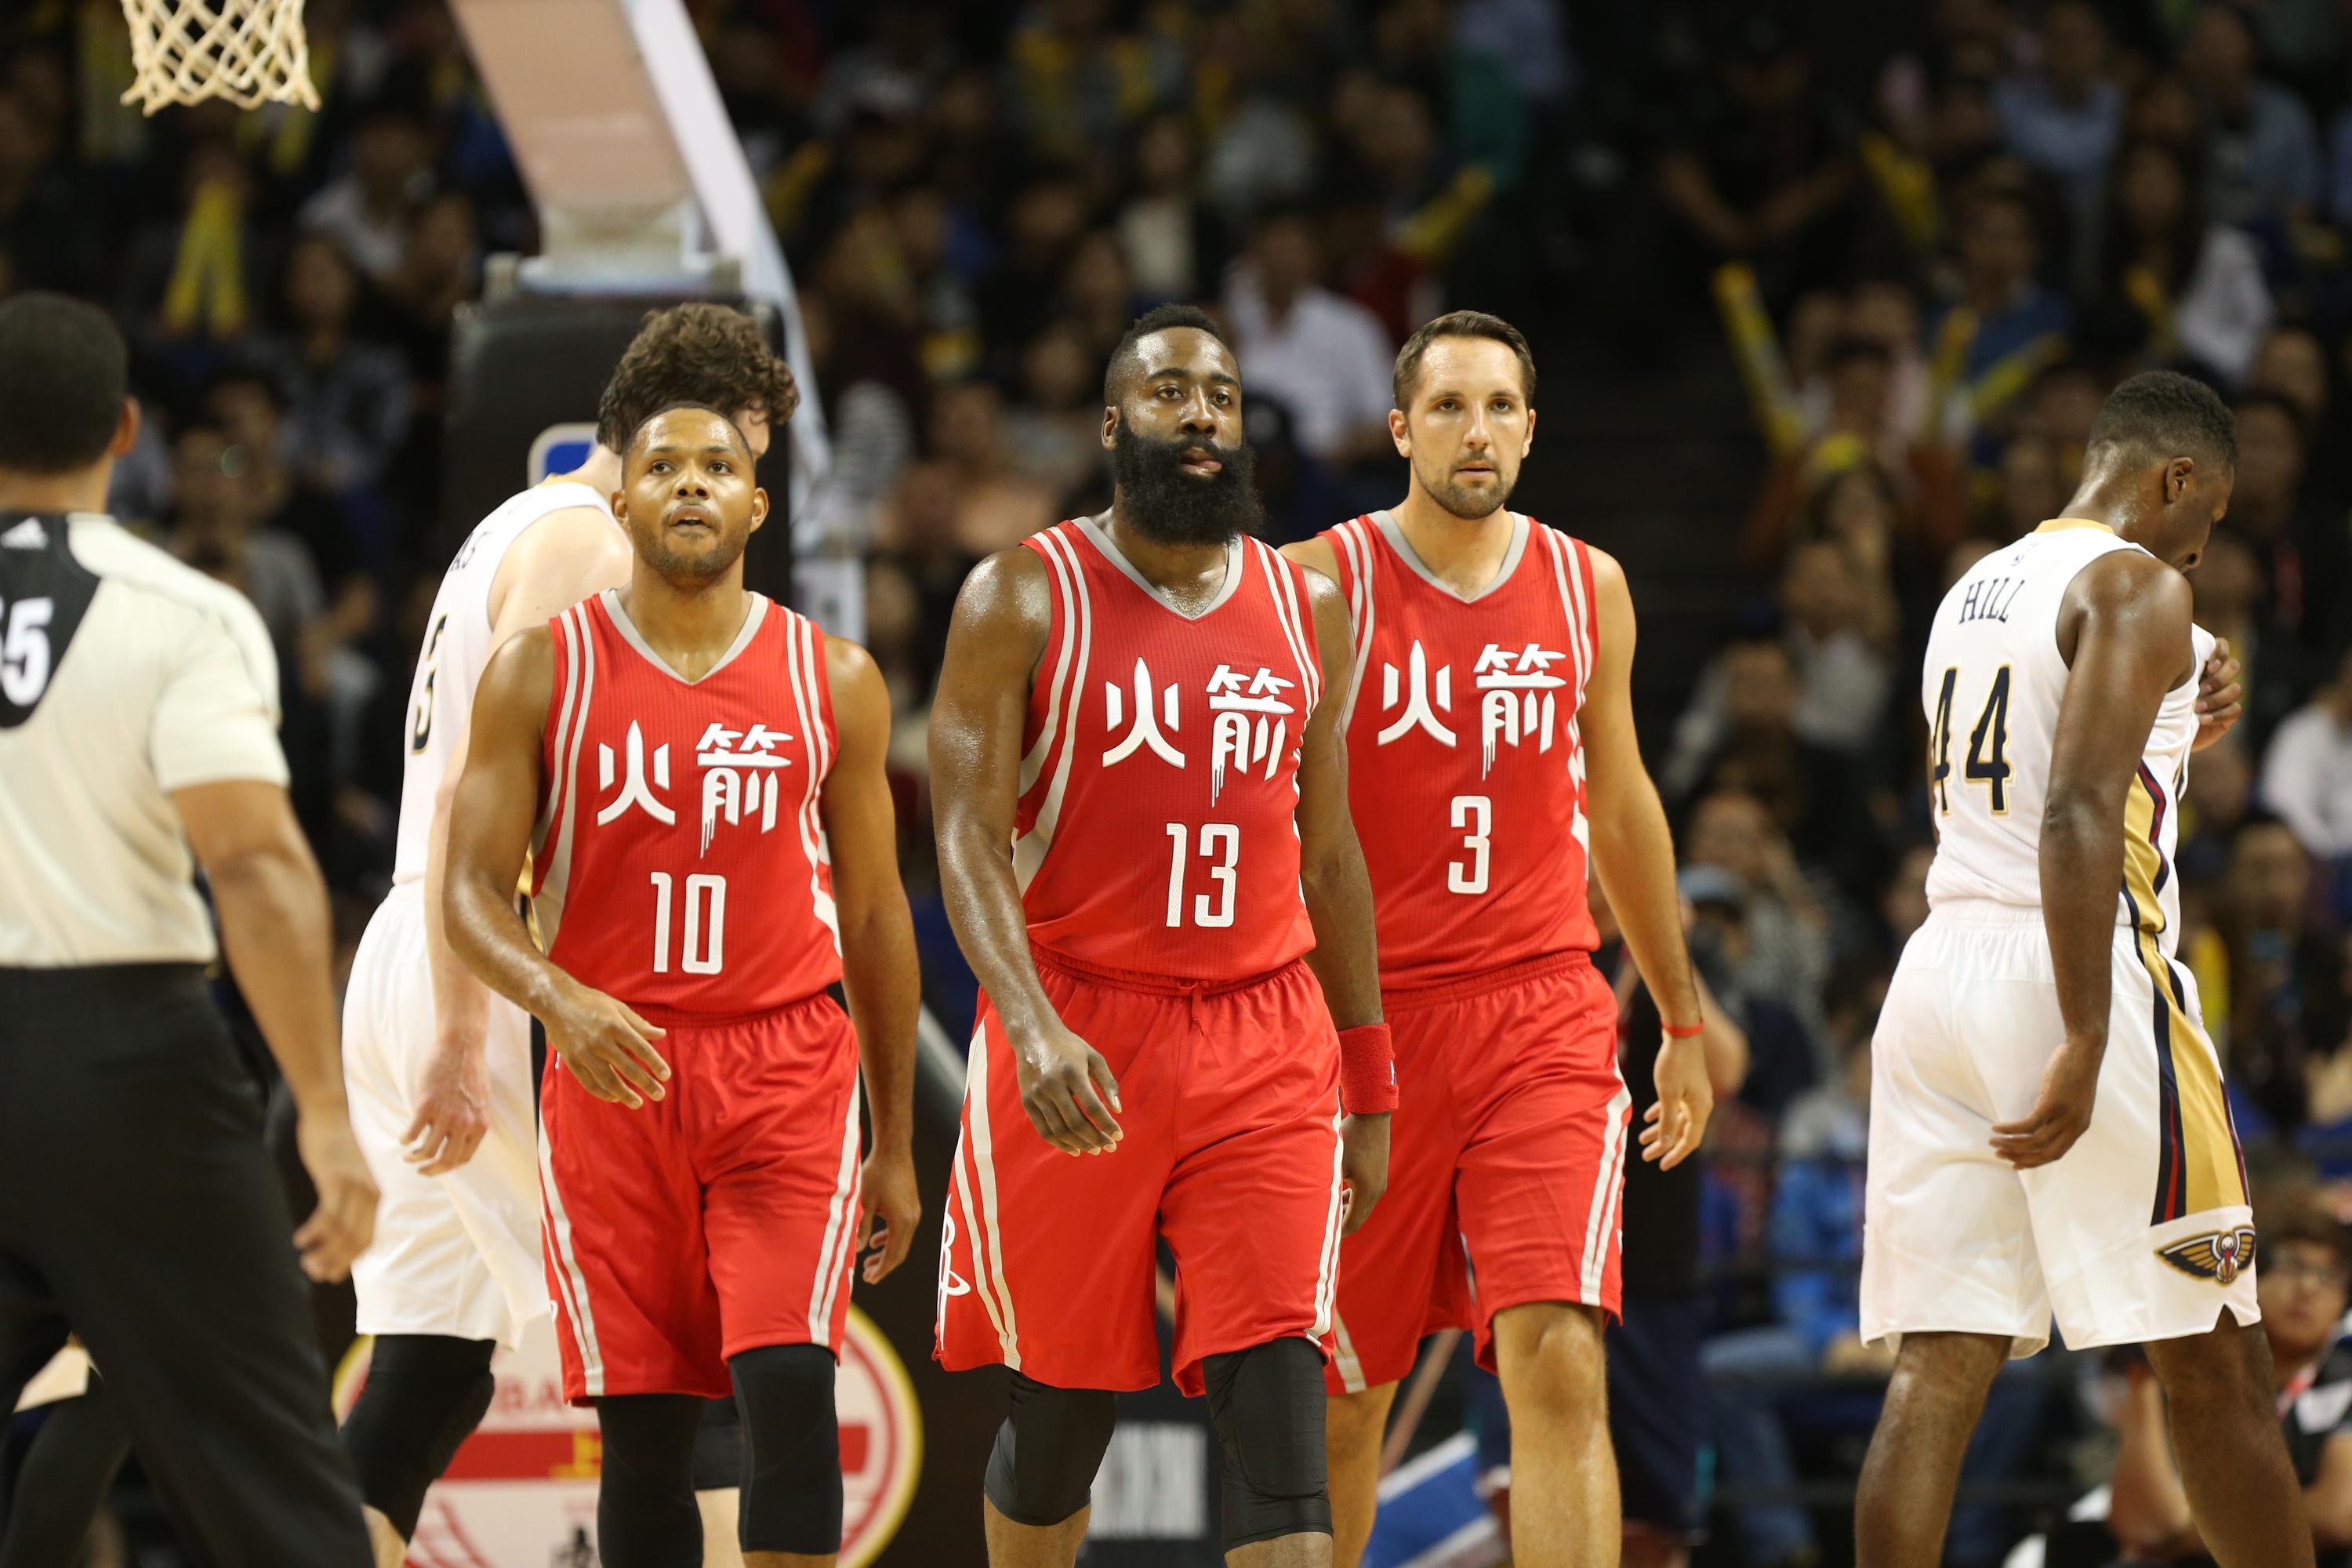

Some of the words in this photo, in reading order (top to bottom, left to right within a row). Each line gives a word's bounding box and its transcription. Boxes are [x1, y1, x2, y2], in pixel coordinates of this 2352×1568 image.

[0, 595, 54, 706] 5
[1959, 576, 2025, 625] HILL
[1102, 656, 1295, 808] 火箭
[1377, 639, 1566, 781] 火箭
[1932, 664, 2015, 816] 44
[597, 719, 793, 859] 火箭
[1165, 822, 1240, 928] 13
[1446, 795, 1493, 895] 3
[650, 871, 727, 975] 10
